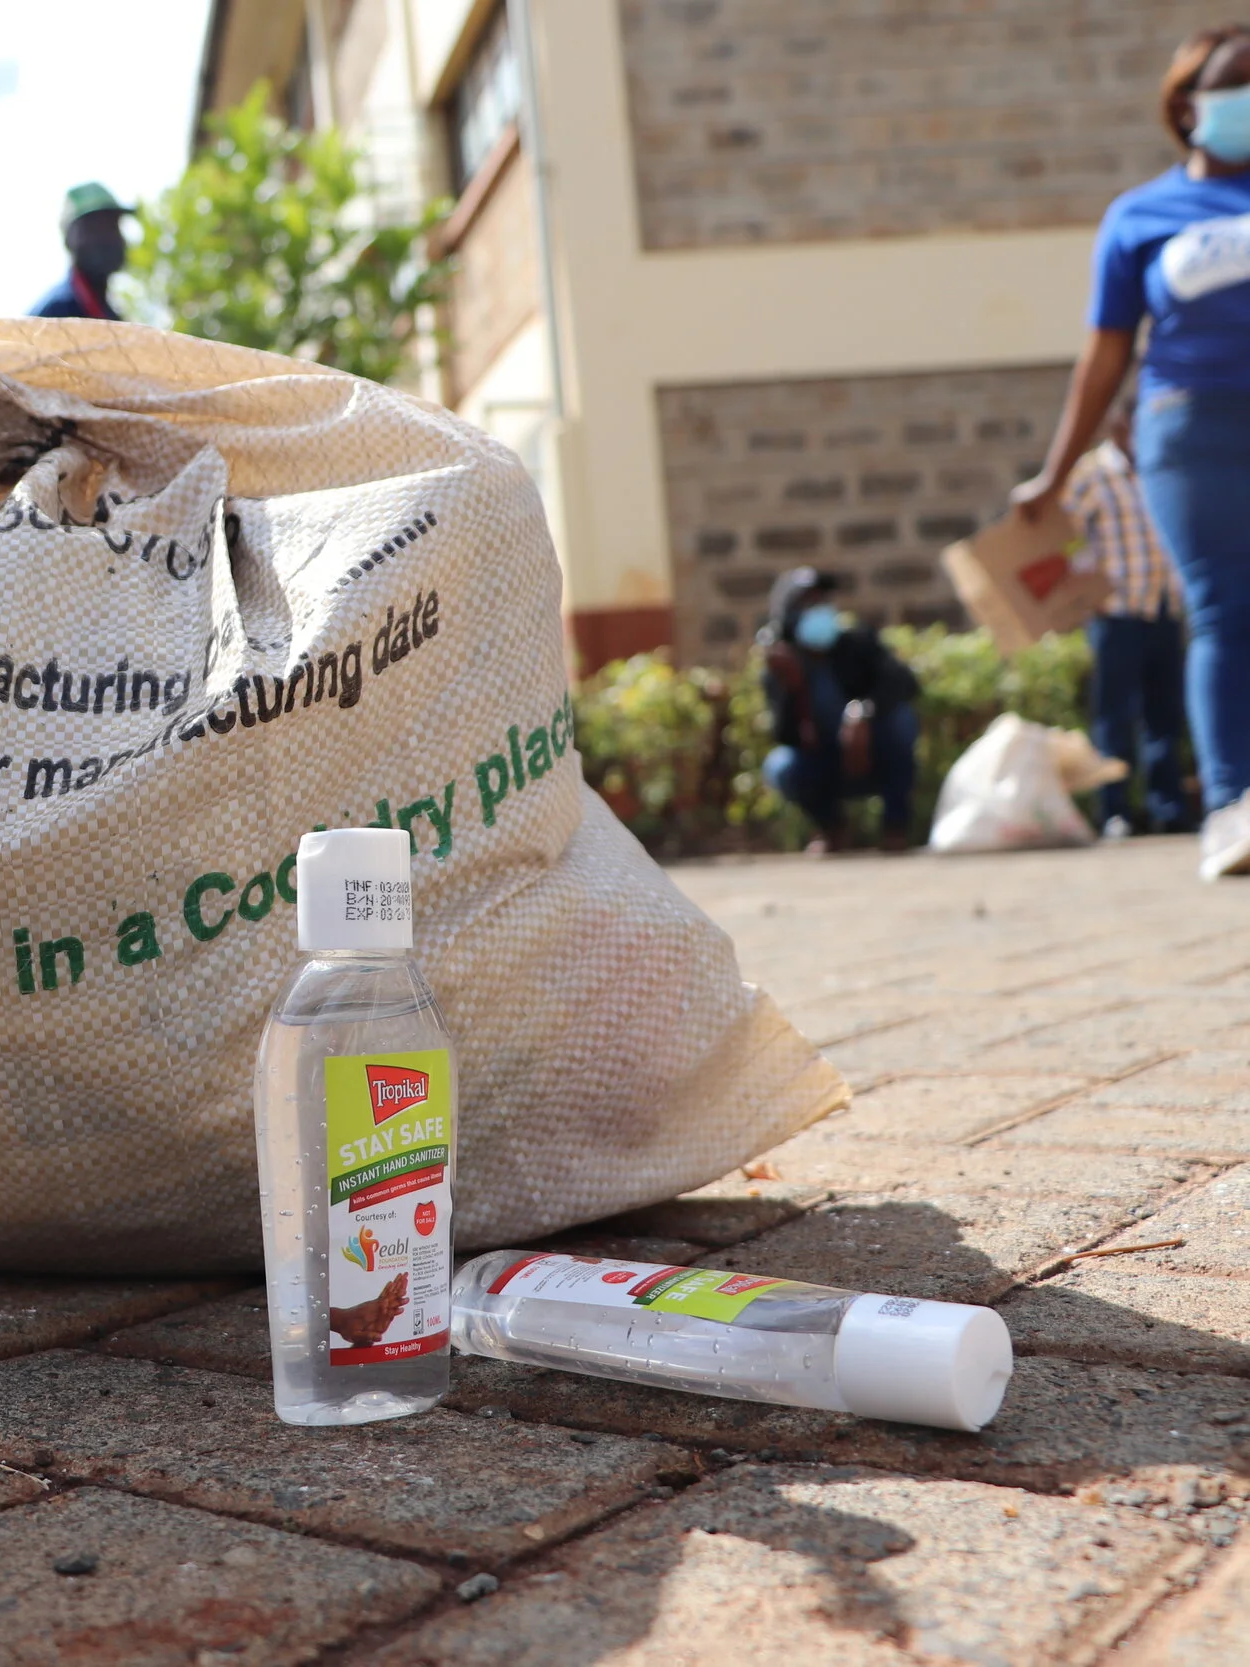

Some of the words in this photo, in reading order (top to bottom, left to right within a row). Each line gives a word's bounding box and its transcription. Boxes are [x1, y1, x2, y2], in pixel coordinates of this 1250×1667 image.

[371, 588, 440, 677] date
[13, 926, 85, 996] in
[116, 910, 163, 967] a
[183, 824, 327, 942] Coo
[372, 1077, 426, 1107] Tropikal
[339, 1128, 395, 1167] STAY
[400, 1117, 444, 1145] SAFE
[338, 1165, 382, 1193] INSTANT
[383, 1156, 408, 1175] HAND
[409, 1147, 446, 1165] SANITIZER
[352, 1196, 366, 1205] kills
[366, 1187, 391, 1201] common
[390, 1182, 407, 1193] germs
[355, 1213, 388, 1223] Courtesy
[379, 1236, 410, 1258] eabl
[384, 1345, 400, 1356] Stay
[399, 1341, 422, 1353] Healthy
